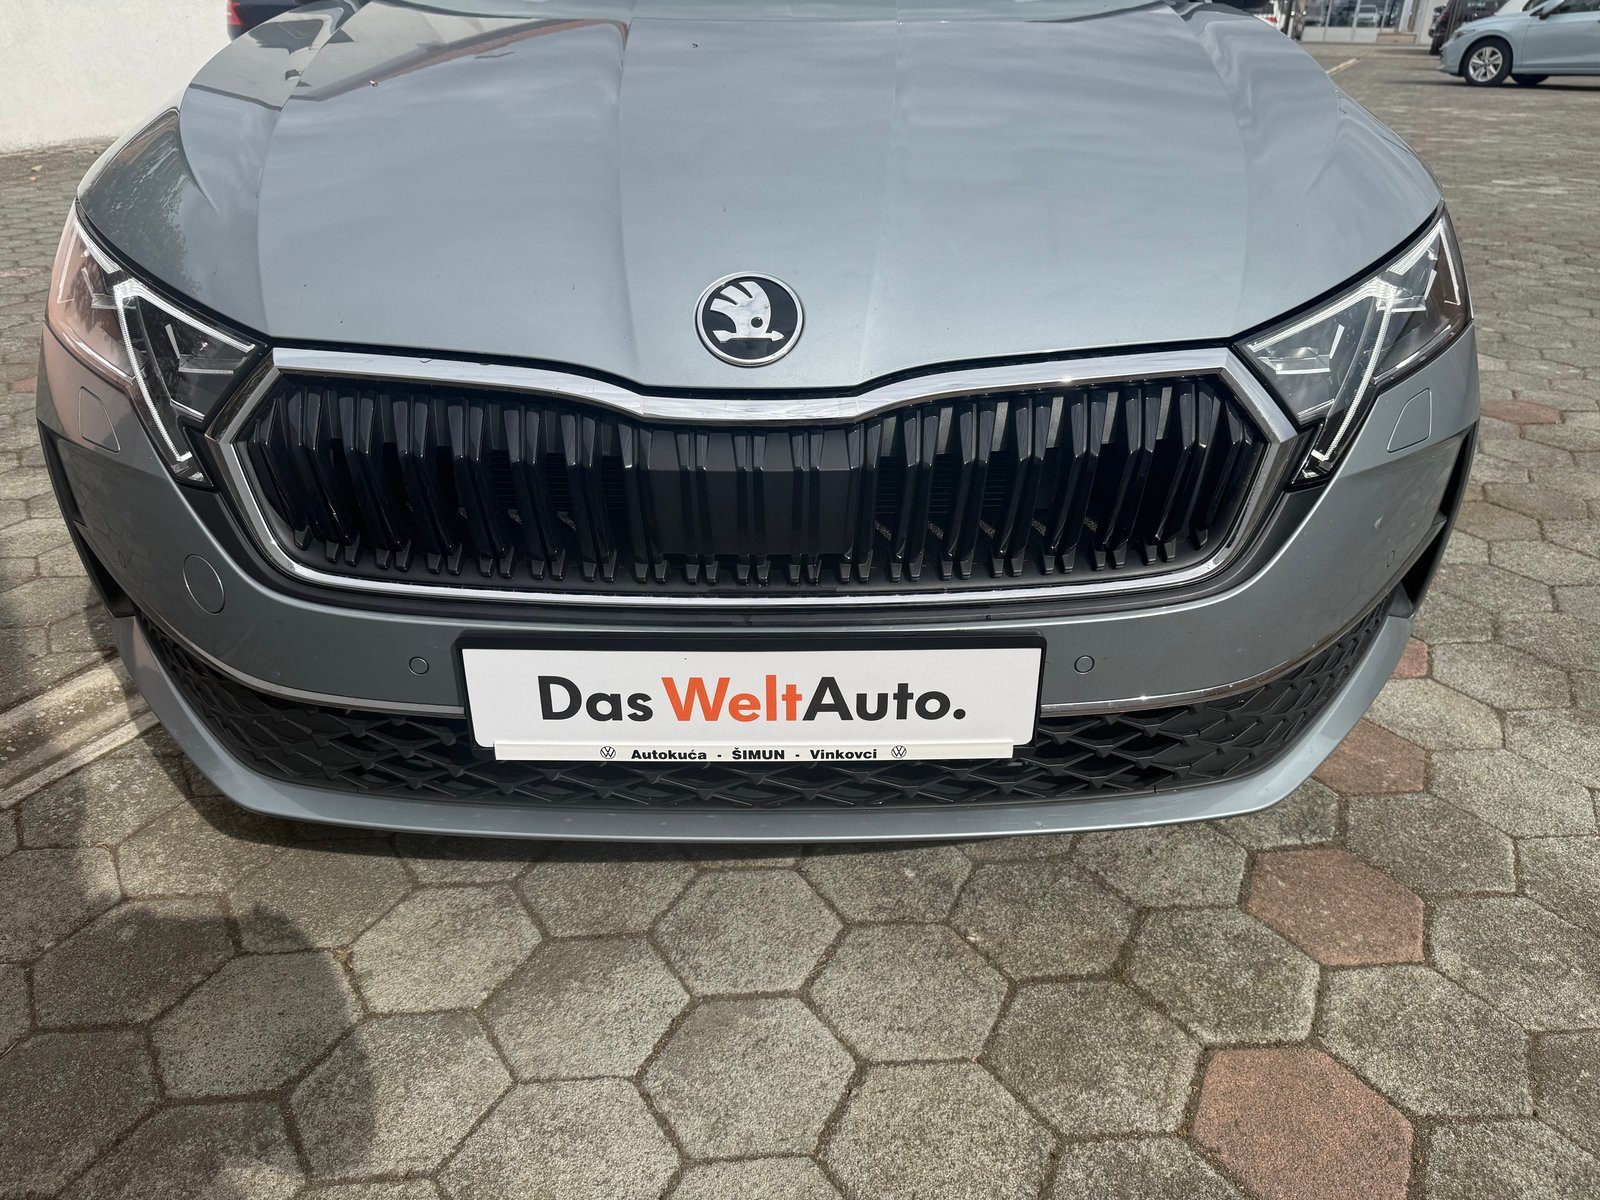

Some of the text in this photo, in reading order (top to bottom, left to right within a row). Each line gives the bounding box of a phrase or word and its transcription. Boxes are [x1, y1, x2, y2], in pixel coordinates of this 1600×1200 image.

[538, 674, 967, 723] Das WeltAuto.
[630, 749, 708, 760] Autokuća
[731, 747, 785, 760] ŠIMUN
[809, 749, 878, 760] Vinkovci
